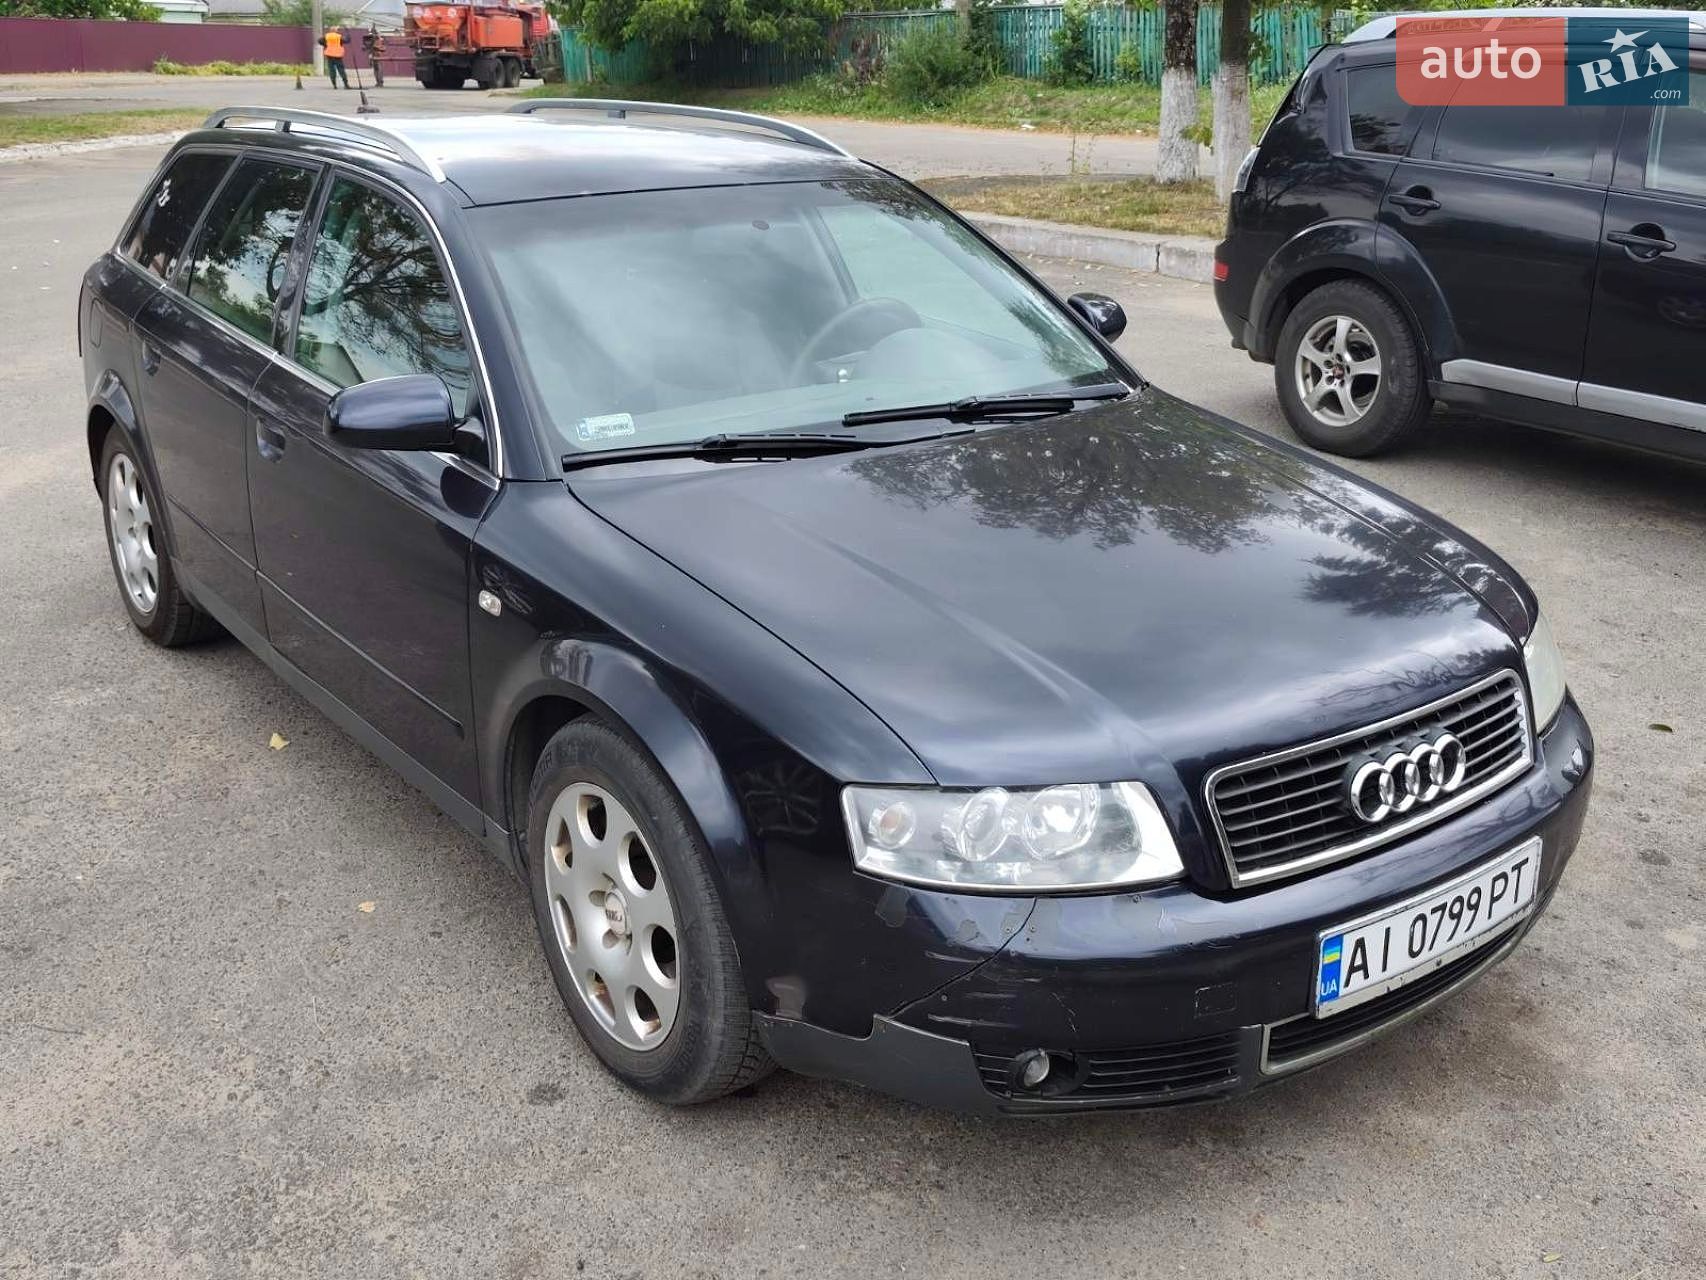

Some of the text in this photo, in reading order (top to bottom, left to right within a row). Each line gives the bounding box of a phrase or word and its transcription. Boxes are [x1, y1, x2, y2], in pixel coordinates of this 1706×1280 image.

[1343, 857, 1529, 988] AI 0799 PT
[1321, 978, 1337, 996] UA
